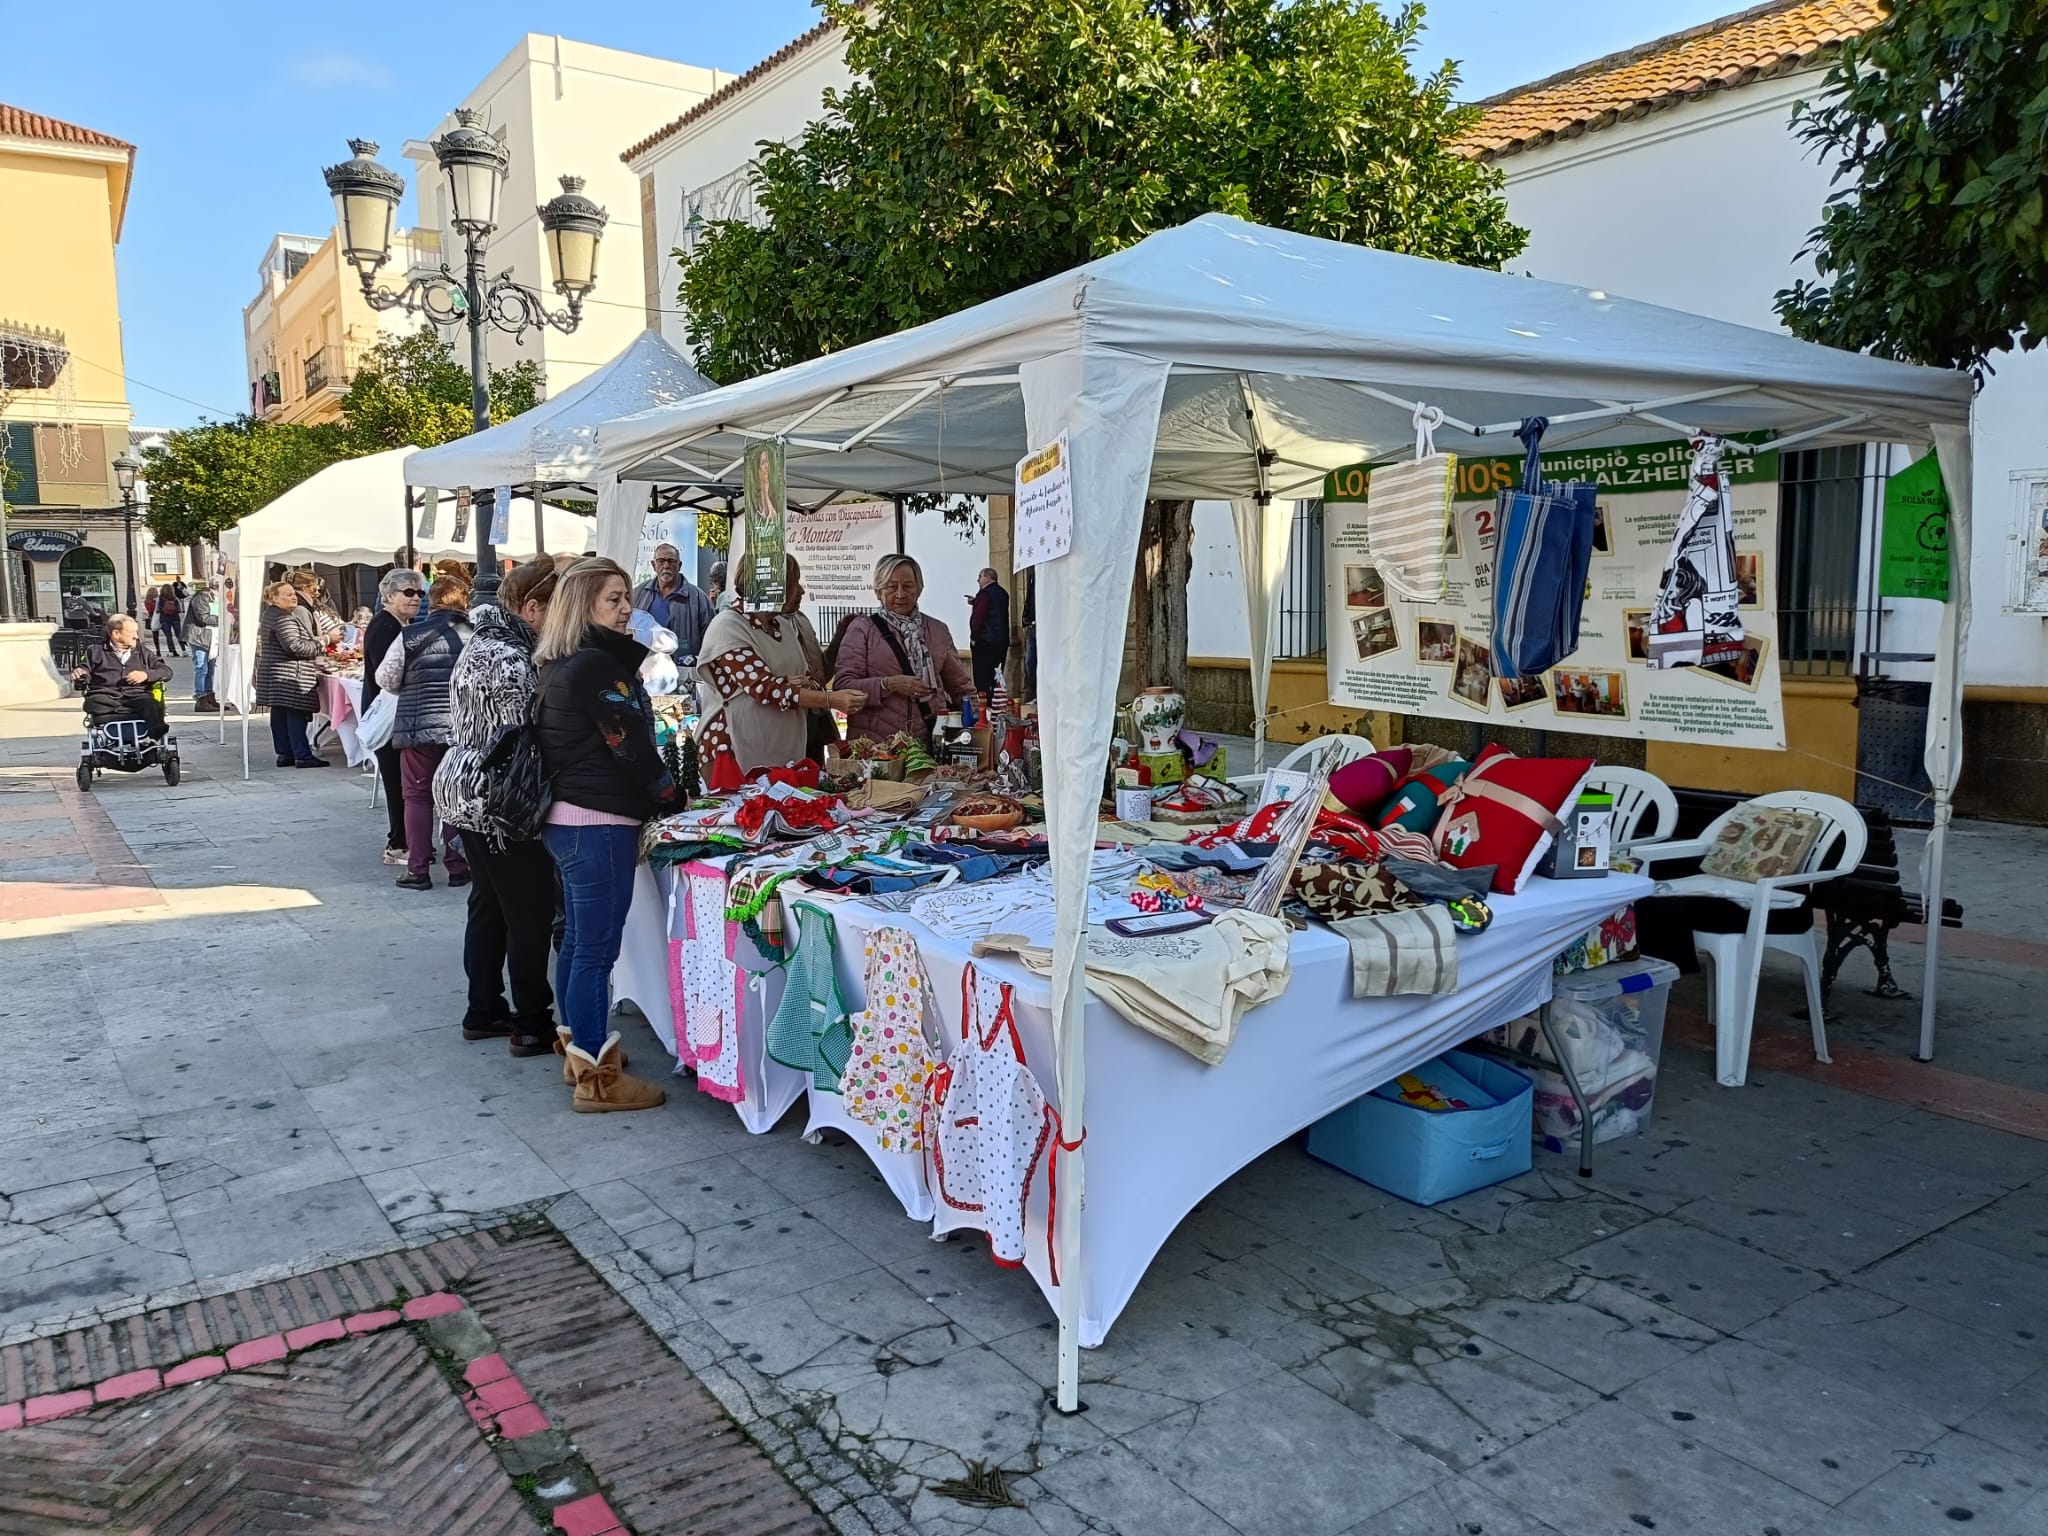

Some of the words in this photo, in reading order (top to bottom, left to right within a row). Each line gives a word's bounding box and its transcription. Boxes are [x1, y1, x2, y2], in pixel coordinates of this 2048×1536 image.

[1595, 458, 1754, 486] ALZHEIER
[826, 513, 836, 521] con
[838, 506, 883, 524] Discapacidad
[1474, 577, 1490, 588] DEL
[1658, 694, 1684, 702] nuestras
[1685, 696, 1726, 704] instalaciones
[1728, 698, 1756, 706] tratamos
[1656, 708, 1682, 716] familias,
[1690, 704, 1714, 712] integral
[1722, 720, 1744, 729] ayudas
